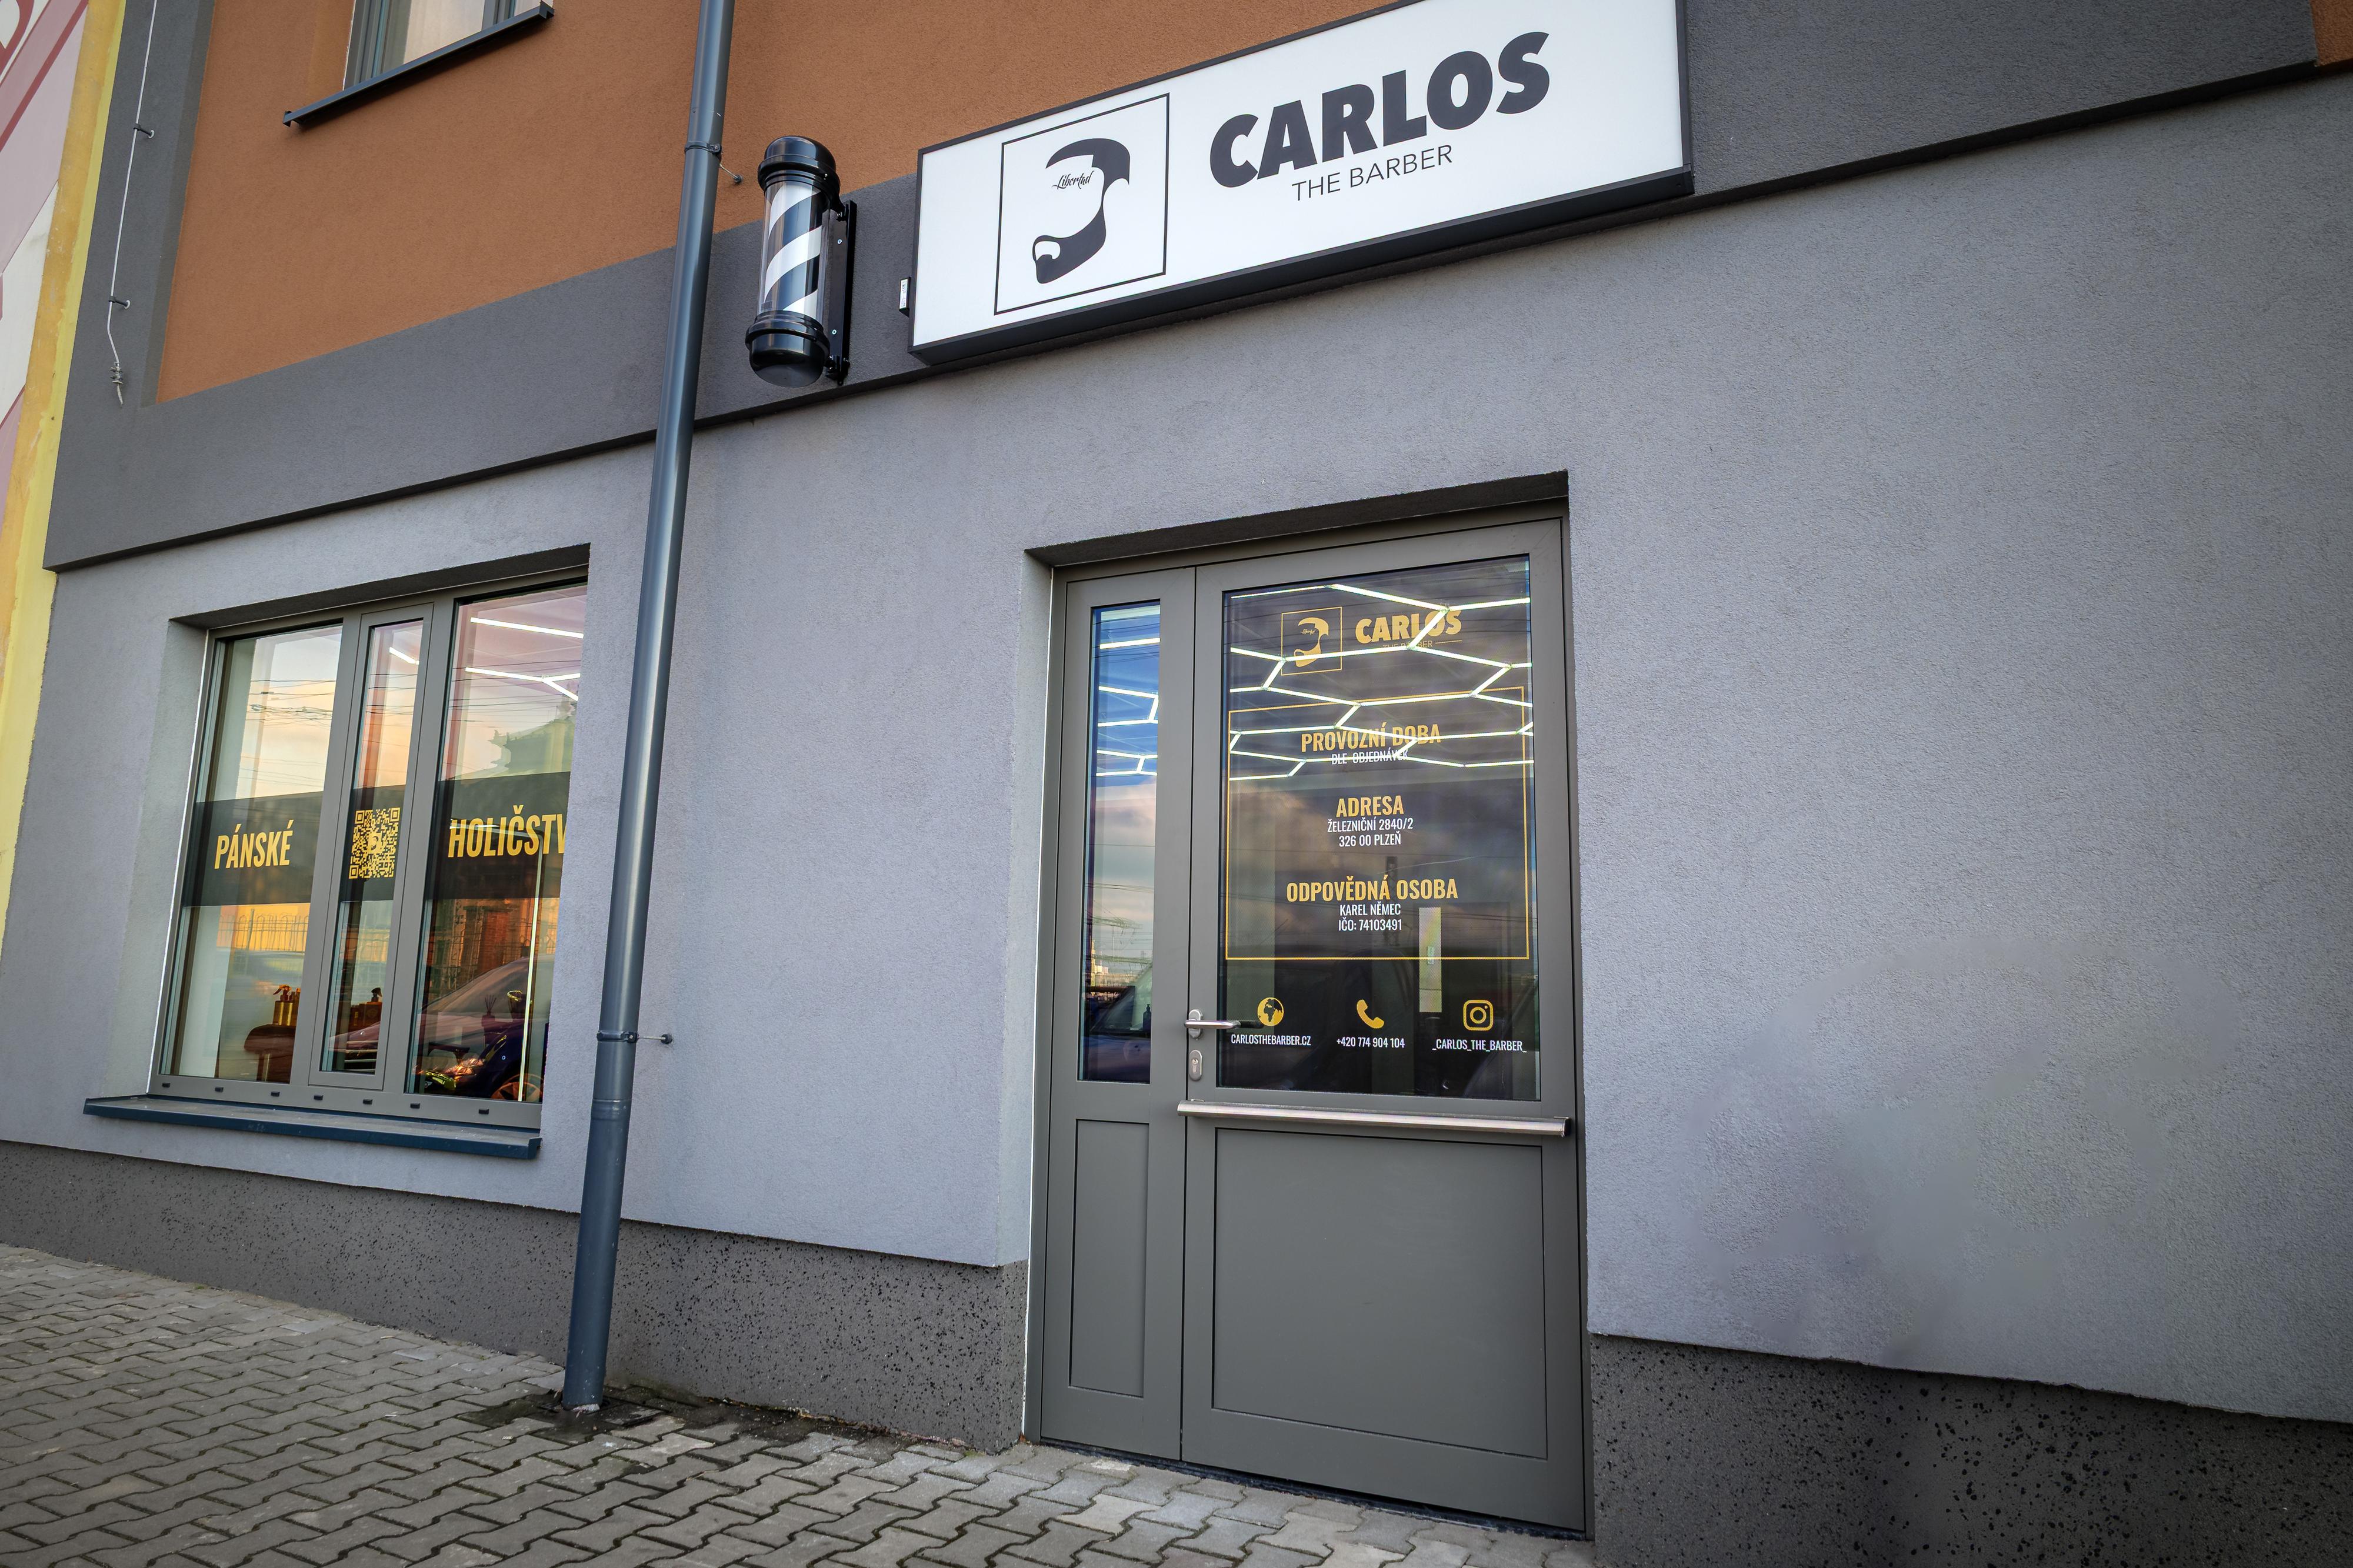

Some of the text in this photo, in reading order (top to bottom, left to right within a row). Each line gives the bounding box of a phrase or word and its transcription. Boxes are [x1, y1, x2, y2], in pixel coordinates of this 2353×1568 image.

[1209, 31, 1550, 188] CARLOS
[1051, 170, 1095, 190] Libertad
[1291, 144, 1453, 201] THE BARBER
[1355, 610, 1462, 644] CARLOS
[1301, 722, 1441, 753] PROVOZNÍ DOBA
[1331, 752, 1348, 765] DLE
[1336, 795, 1405, 818] ADRESA
[1327, 816, 1414, 833] ŽELEZNIČNÍ 2840/2
[214, 819, 295, 869] PÁNSKÉ
[1338, 830, 1401, 848] 326 00 PLZEŇ
[1287, 875, 1458, 902] ODPOVĚDNÁ OSOBA
[1339, 901, 1401, 916] KAREL NĚMEC
[1338, 917, 1402, 932] IČO: 74103491
[1231, 1034, 1312, 1046] CARLOSTHEBARBER.CZ
[1337, 1036, 1405, 1048] +420 774 904 104
[1432, 1039, 1527, 1053] _CARLOS_THE_BARBER_
